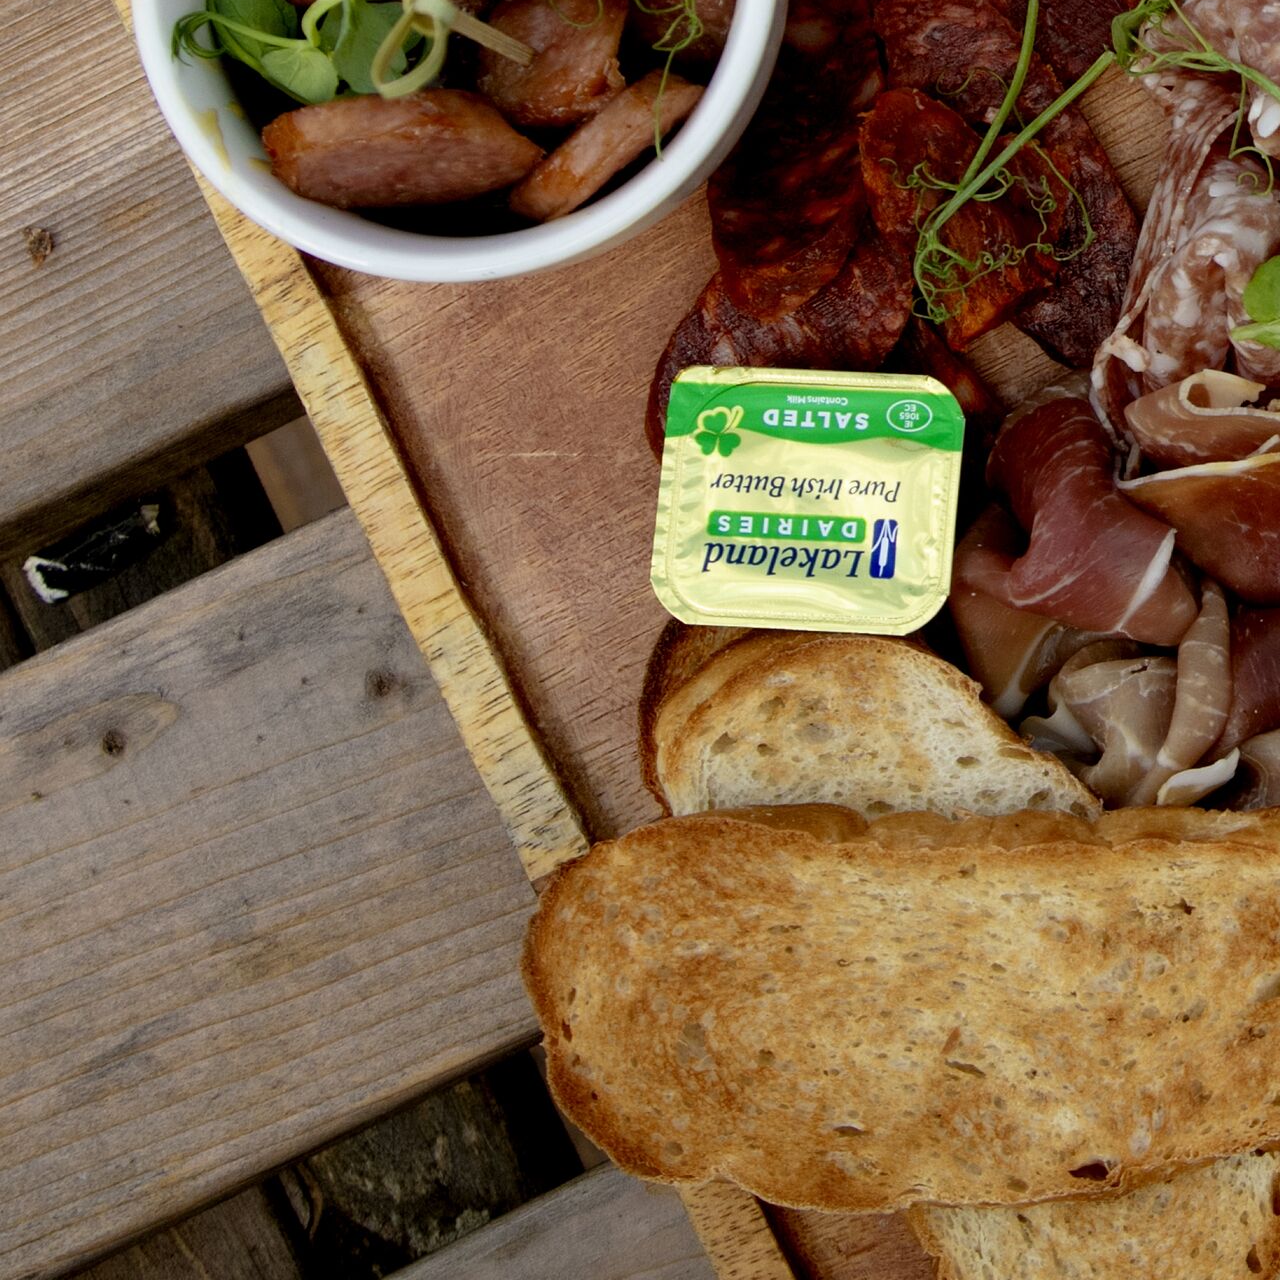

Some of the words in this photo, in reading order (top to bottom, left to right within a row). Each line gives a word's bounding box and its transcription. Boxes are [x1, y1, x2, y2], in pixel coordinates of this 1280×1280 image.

[786, 394, 806, 404] Milk
[806, 395, 849, 406] Contains
[763, 408, 870, 430] SALTED
[710, 473, 786, 498] Butter
[791, 477, 843, 500] Irish
[849, 479, 901, 503] Pure
[717, 515, 858, 538] DAIRIES
[702, 542, 864, 578] Lakeland
